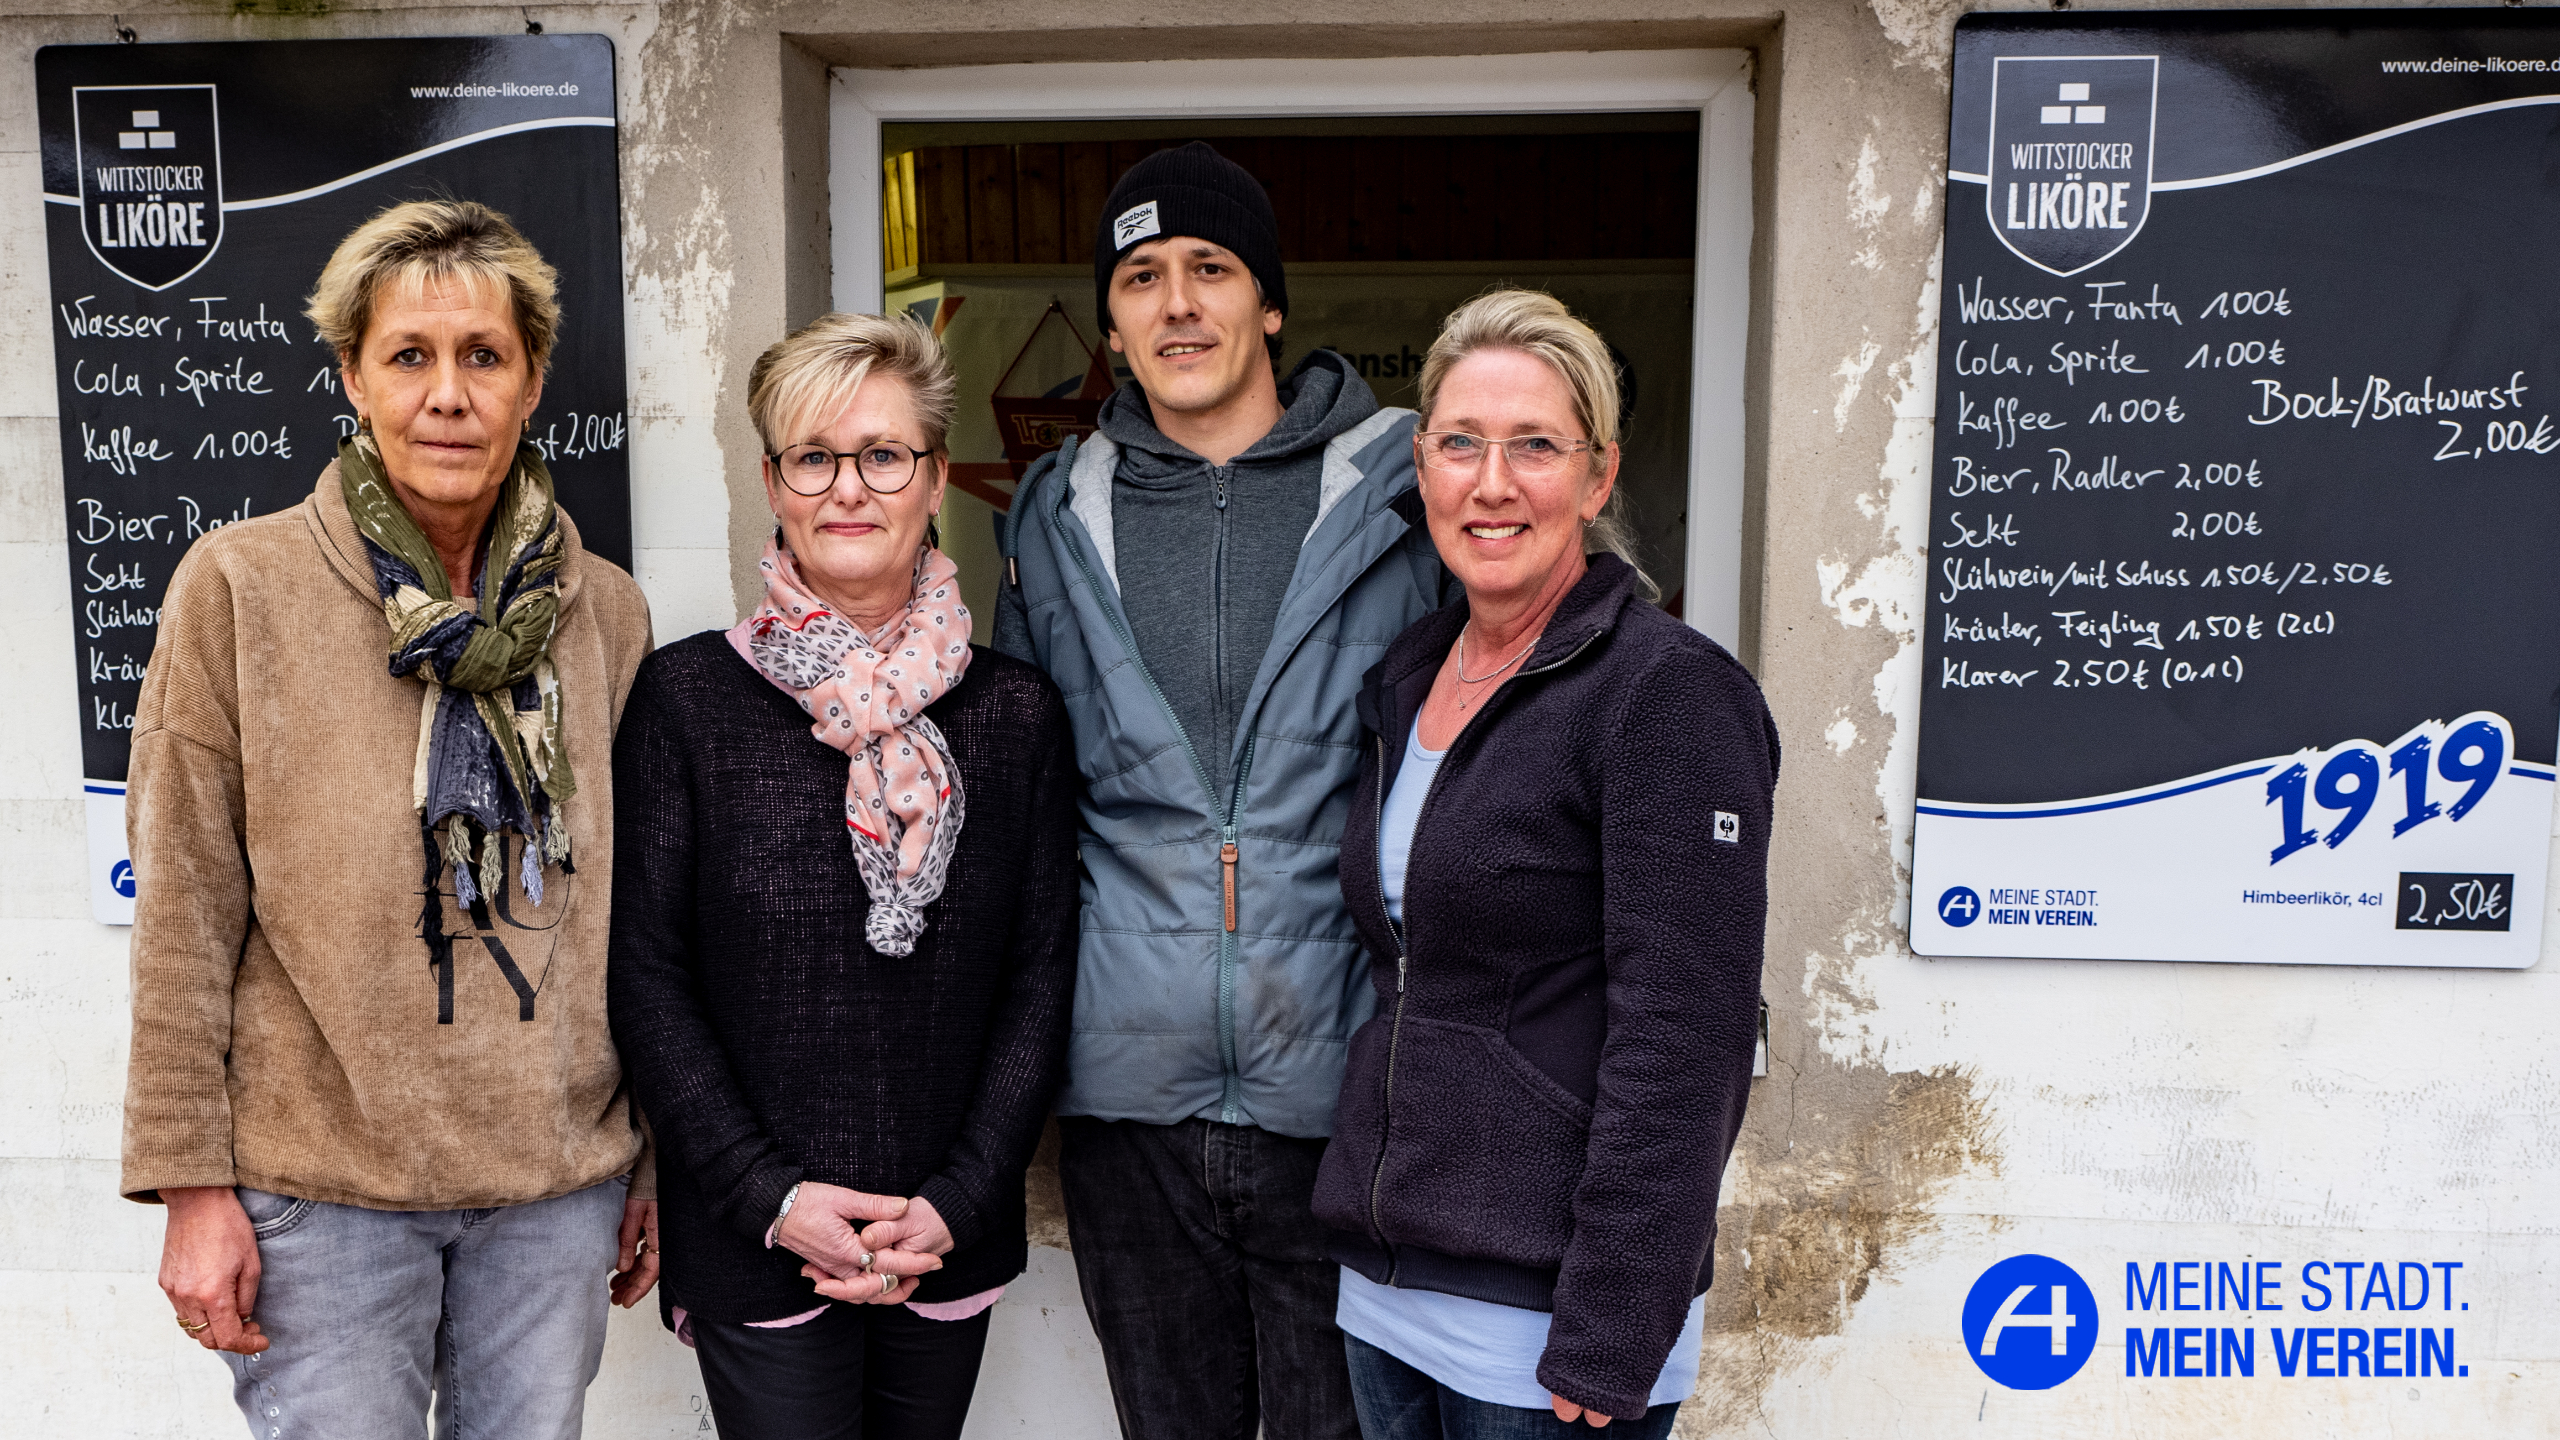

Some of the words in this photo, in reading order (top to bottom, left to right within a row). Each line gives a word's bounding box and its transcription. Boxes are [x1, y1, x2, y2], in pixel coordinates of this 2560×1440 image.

[2381, 56, 2560, 73] www.deine-likoere.d
[410, 81, 579, 100] www.deine-likoere.de
[2011, 143, 2133, 171] WITTSTOCKER
[96, 165, 203, 192] WITTSTOCKER
[99, 195, 207, 248] LIKÖRE
[1117, 207, 1153, 229] Reebok
[2006, 173, 2129, 231] LIKÖRE
[60, 295, 182, 342] Wasser,
[189, 297, 292, 345] Fanta
[1958, 276, 2075, 325] Wasser,
[2085, 281, 2183, 325] Fanta
[175, 356, 274, 408] Sprite
[1955, 340, 2034, 376] Cola,
[2048, 339, 2150, 386] Sprite
[1957, 391, 2068, 449] Kaffee
[2433, 414, 2560, 461] 2,00€
[82, 422, 174, 476] Kaffee
[1948, 456, 2040, 498] Bier,
[2047, 448, 2166, 492] Radler
[2174, 458, 2264, 491] 2,00€
[77, 498, 174, 545] Bier,
[1942, 512, 2020, 548] Sekt
[2172, 511, 2263, 541] 2,00€
[84, 553, 146, 593] Sekt
[2116, 560, 2191, 587] Schuss
[1943, 611, 2042, 647] Kräuter,
[2051, 610, 2165, 650] Feigling
[2277, 610, 2335, 637] (2cl)
[90, 646, 148, 684] Kräu
[1941, 656, 2040, 689] Klarer
[94, 695, 136, 730] Kla
[2266, 718, 2506, 867] 1919
[1988, 889, 2041, 906] MEINE
[2044, 890, 2099, 907] STADT.
[1988, 909, 2029, 926] MEIN
[2033, 910, 2098, 927] VEREIN.
[2242, 889, 2354, 909] Himbeerlikör,
[2357, 891, 2383, 907] 4cl
[2407, 881, 2508, 926] 2,50€
